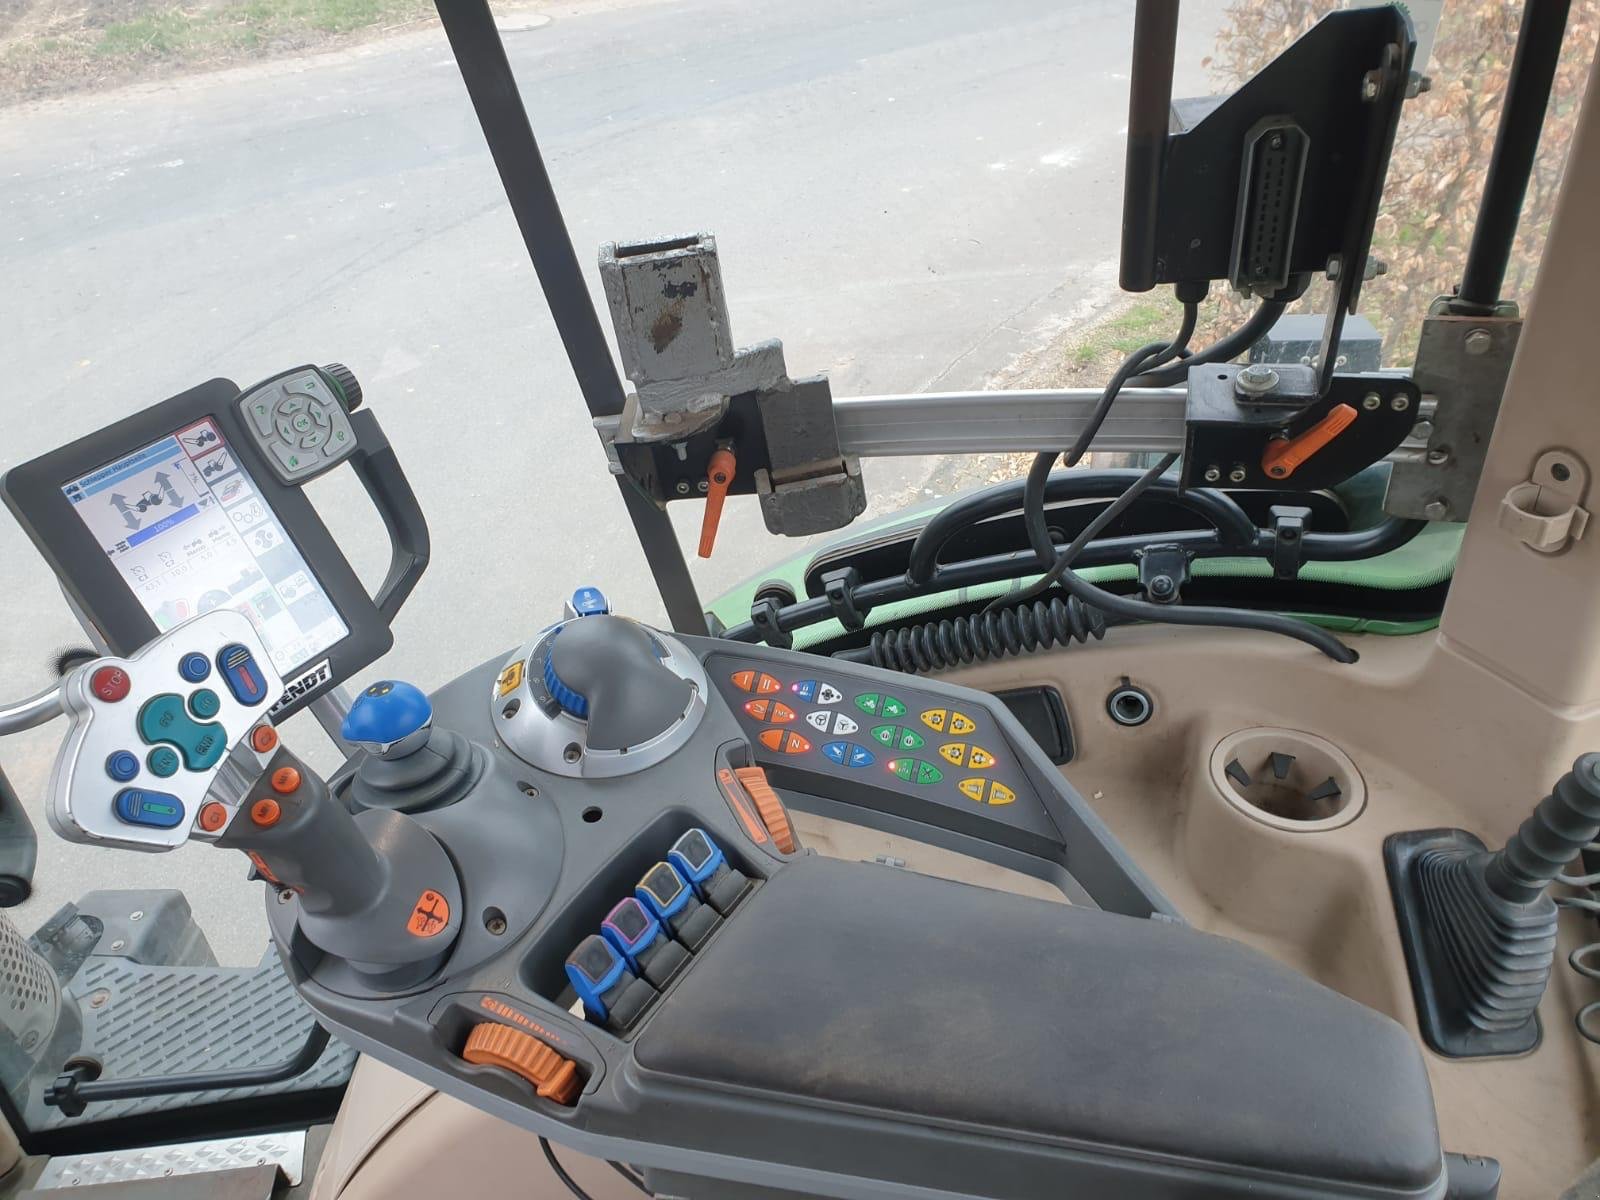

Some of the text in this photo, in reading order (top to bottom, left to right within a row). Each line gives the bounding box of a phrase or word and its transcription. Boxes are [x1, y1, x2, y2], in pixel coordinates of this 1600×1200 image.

[296, 418, 309, 430] OK
[153, 518, 175, 533] 100%
[101, 670, 125, 697] STOP
[791, 738, 801, 750] N
